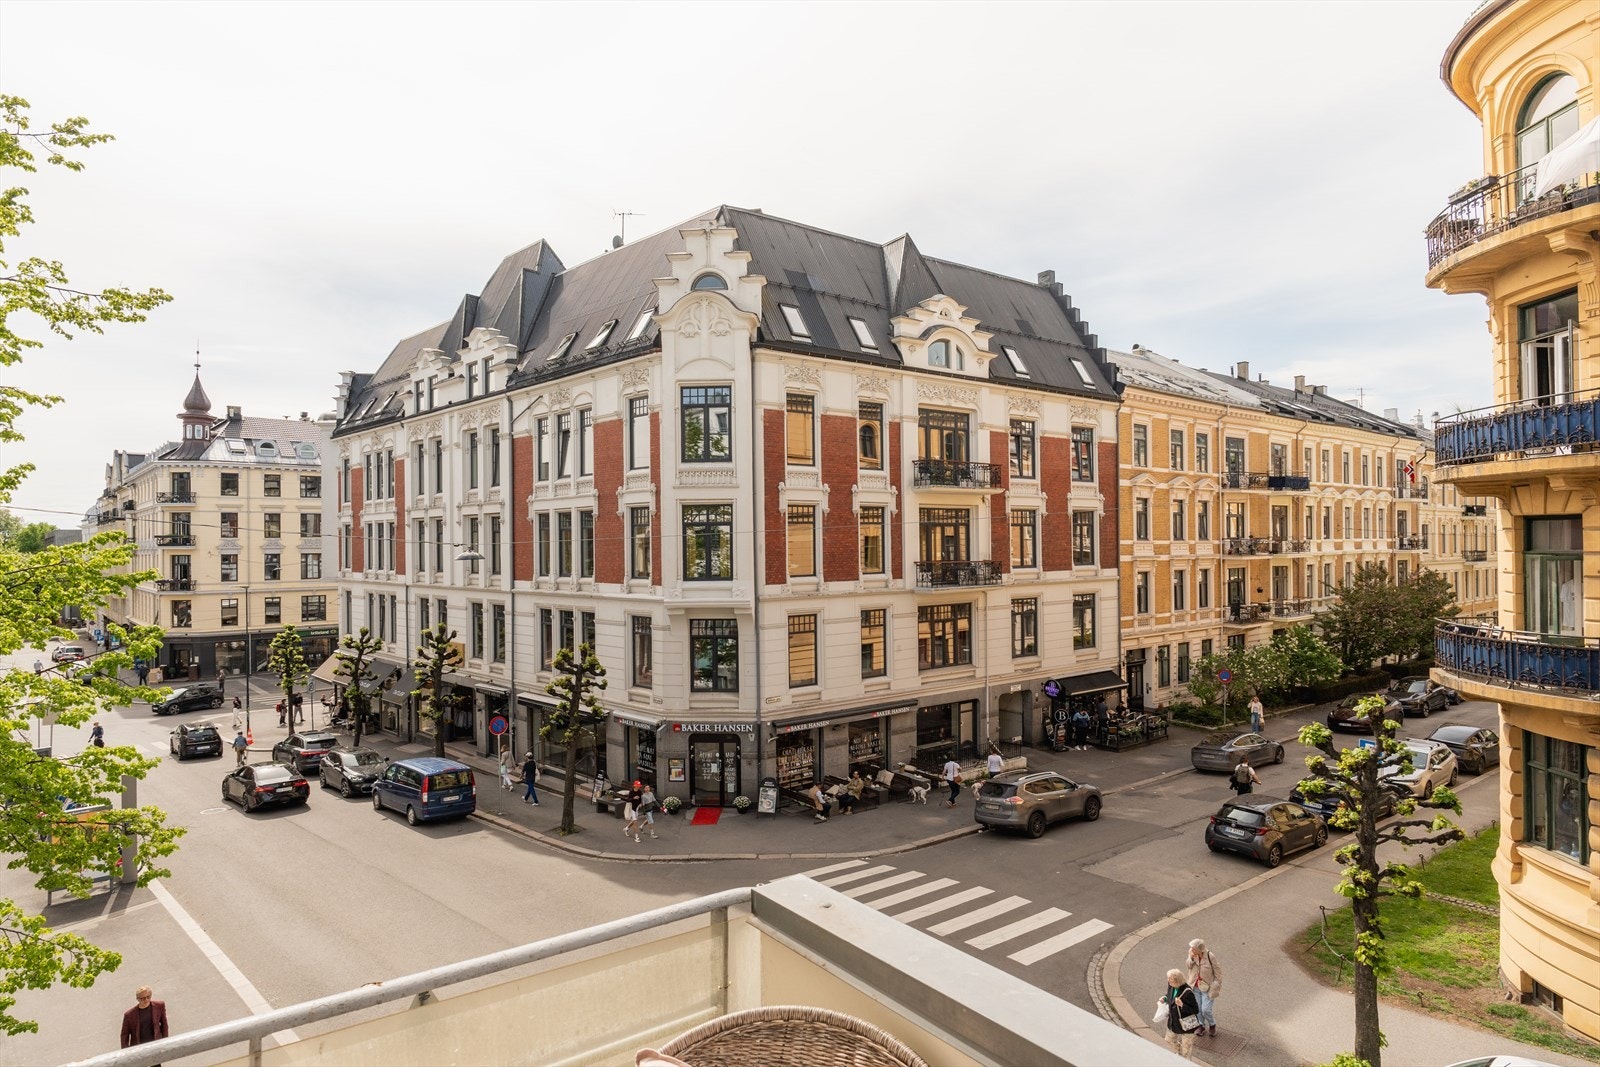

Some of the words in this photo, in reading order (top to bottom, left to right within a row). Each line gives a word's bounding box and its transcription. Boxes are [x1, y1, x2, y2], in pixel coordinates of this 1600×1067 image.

[876, 709, 891, 717] BAKER
[1059, 711, 1066, 720] B
[682, 724, 711, 732] BAKER
[714, 724, 753, 732] HANSEN
[790, 723, 807, 731] BAKER
[809, 720, 829, 729] HANSEN
